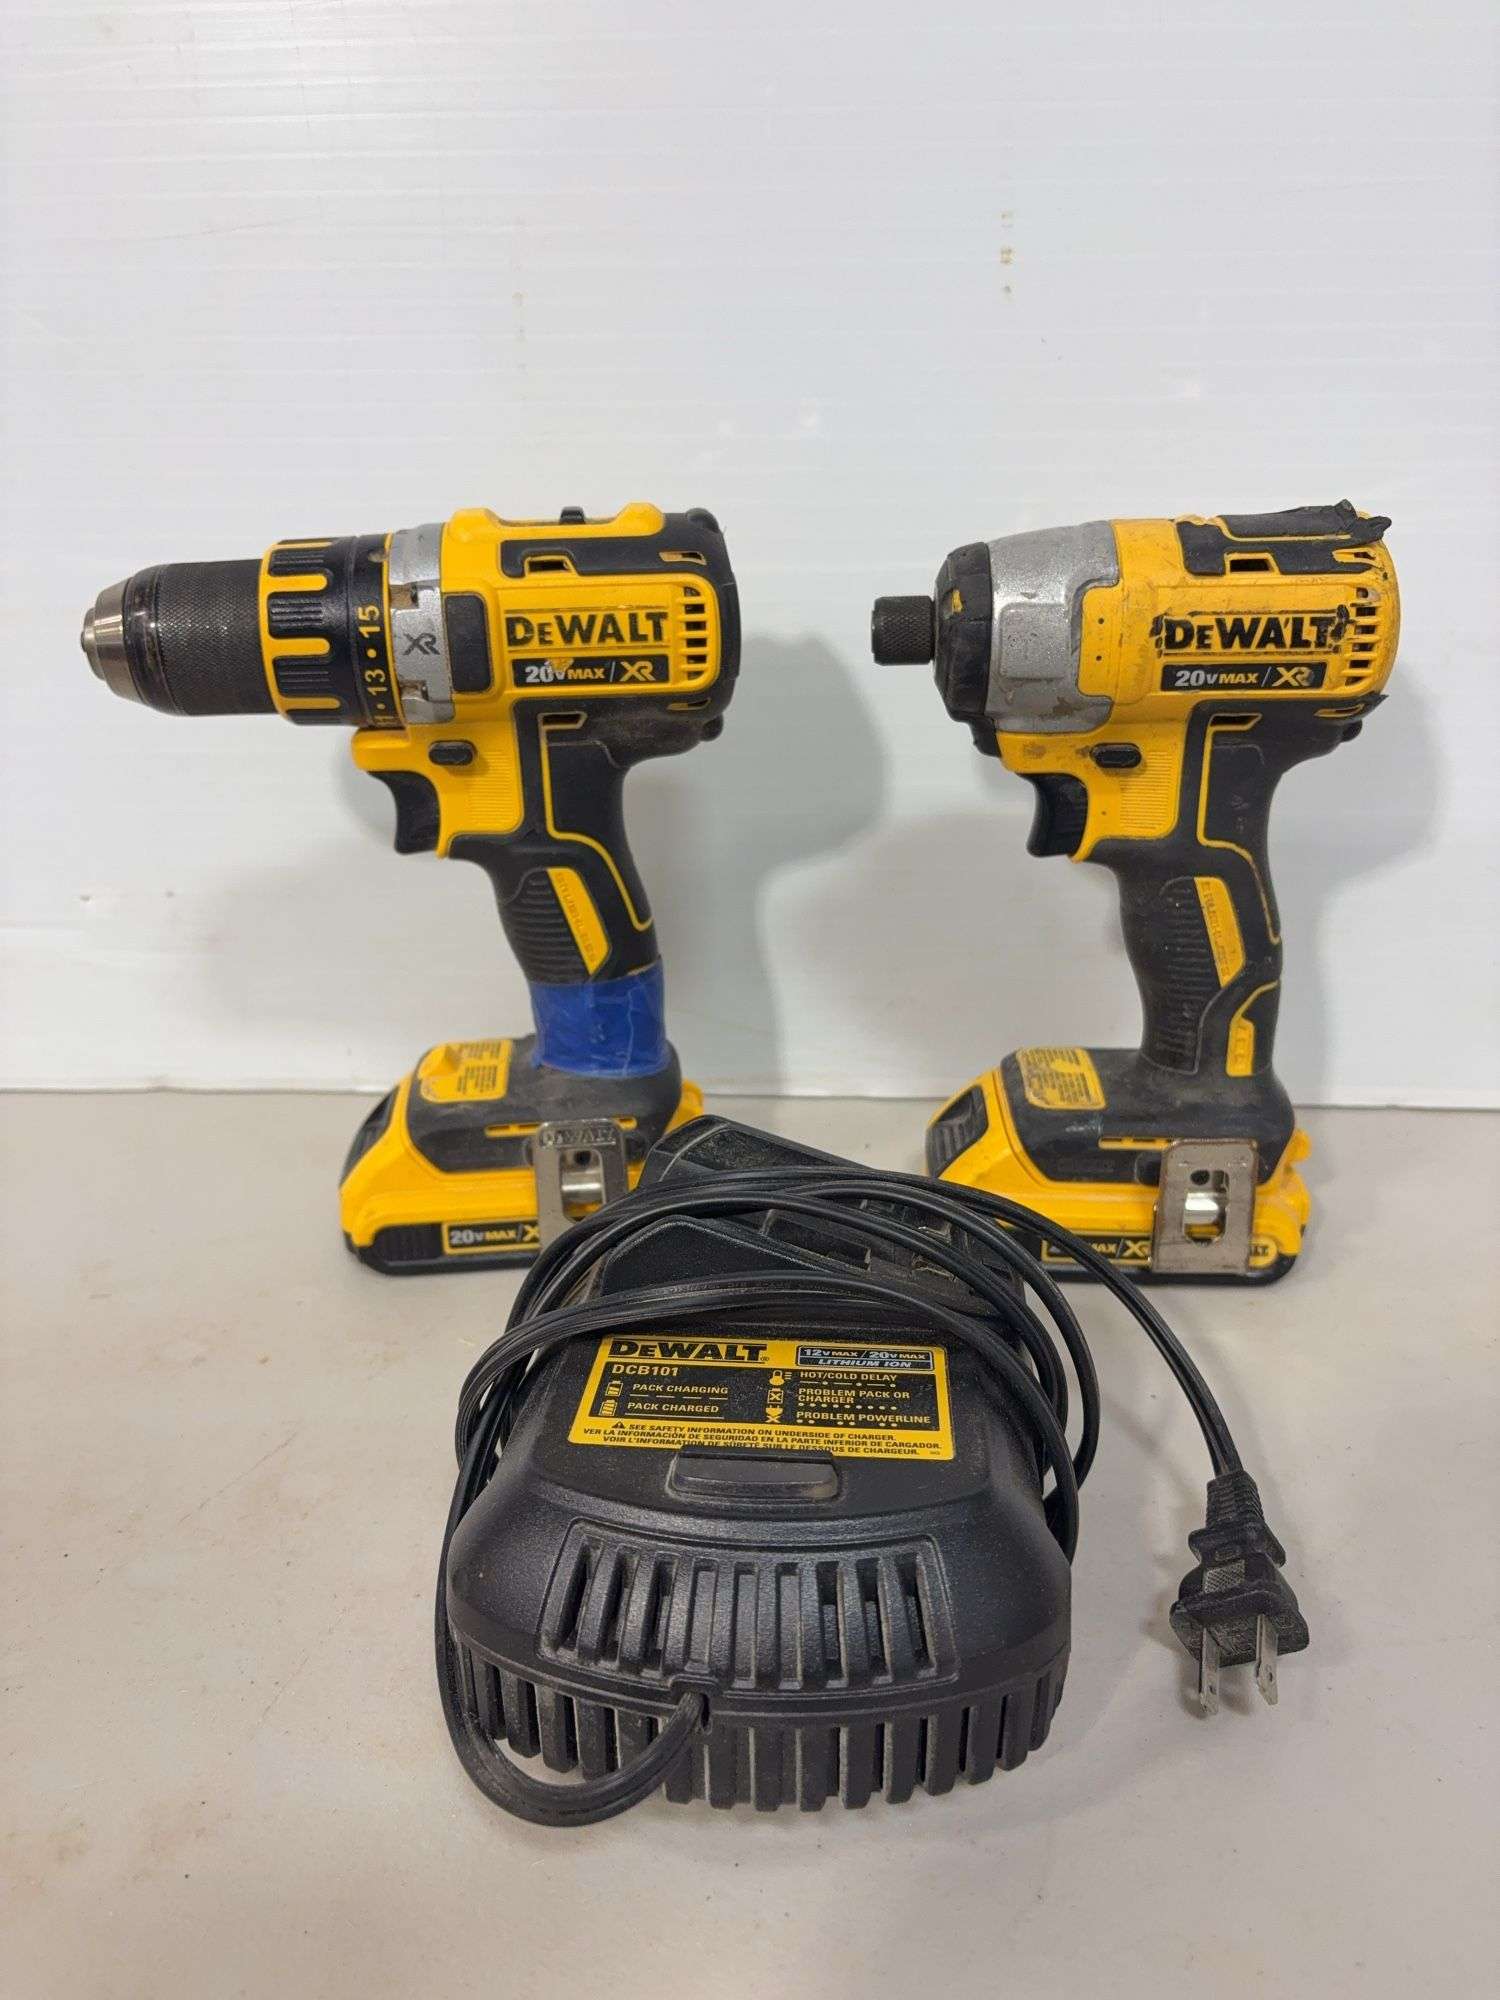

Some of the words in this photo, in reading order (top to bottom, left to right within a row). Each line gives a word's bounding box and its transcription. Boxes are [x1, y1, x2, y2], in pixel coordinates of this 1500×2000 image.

[357, 604, 381, 639] 15
[505, 611, 668, 647] DEWALT
[402, 632, 441, 656] XR
[619, 660, 656, 682] XR
[364, 669, 388, 696] 13
[818, 1358, 880, 1367] LITHIUM
[882, 1360, 912, 1368] ION
[611, 1364, 680, 1377] DCB101
[800, 1371, 858, 1380] HOT/COLD
[860, 1373, 898, 1382] DELAY
[632, 1383, 664, 1393] PACK
[666, 1385, 729, 1395] CHARGING
[798, 1388, 856, 1397] PROBLEM
[859, 1390, 890, 1398] PACK
[893, 1391, 910, 1399] OR
[798, 1395, 855, 1404] CHARGER
[627, 1402, 658, 1411] PACK
[661, 1404, 719, 1413] CHARGED
[796, 1411, 856, 1421] PROBLEM
[858, 1414, 931, 1424] POWERLINE
[687, 1427, 755, 1435] INFORMATION
[775, 1430, 831, 1438] UNDERSIDE
[704, 1434, 758, 1442] SEGURIDAD
[824, 1439, 868, 1447] INFERIOR
